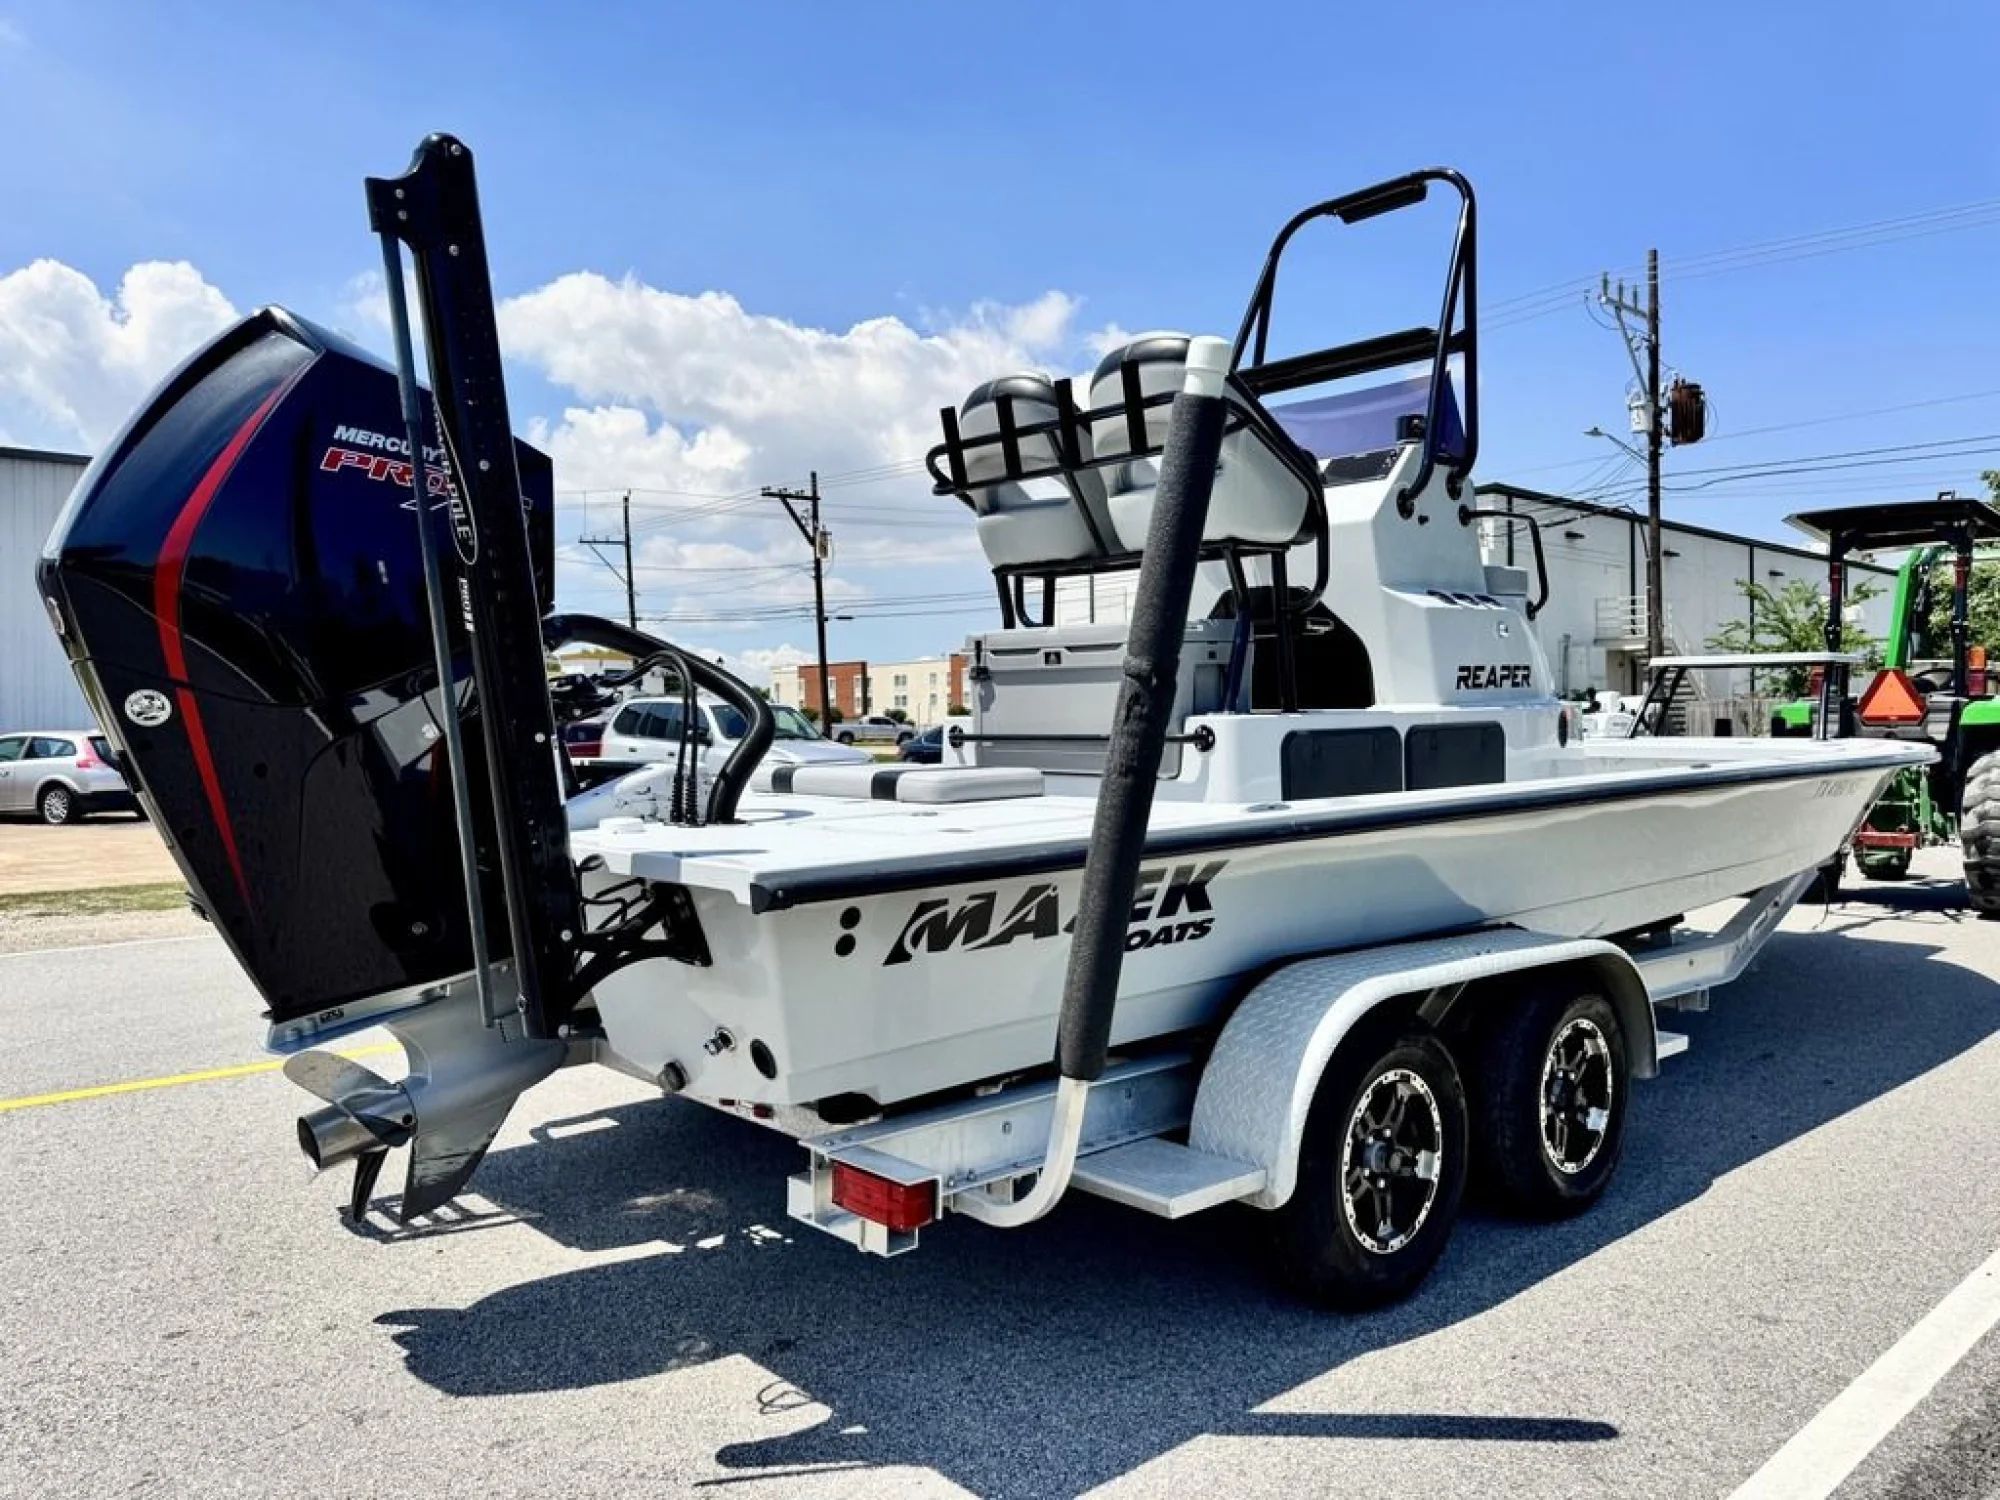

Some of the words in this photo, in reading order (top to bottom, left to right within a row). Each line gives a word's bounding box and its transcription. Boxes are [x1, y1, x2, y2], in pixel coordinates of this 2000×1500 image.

[333, 424, 445, 462] MERCUY
[1456, 664, 1532, 690] REAPER
[883, 859, 1230, 966] MAEK
[1124, 917, 1216, 952] OATS
